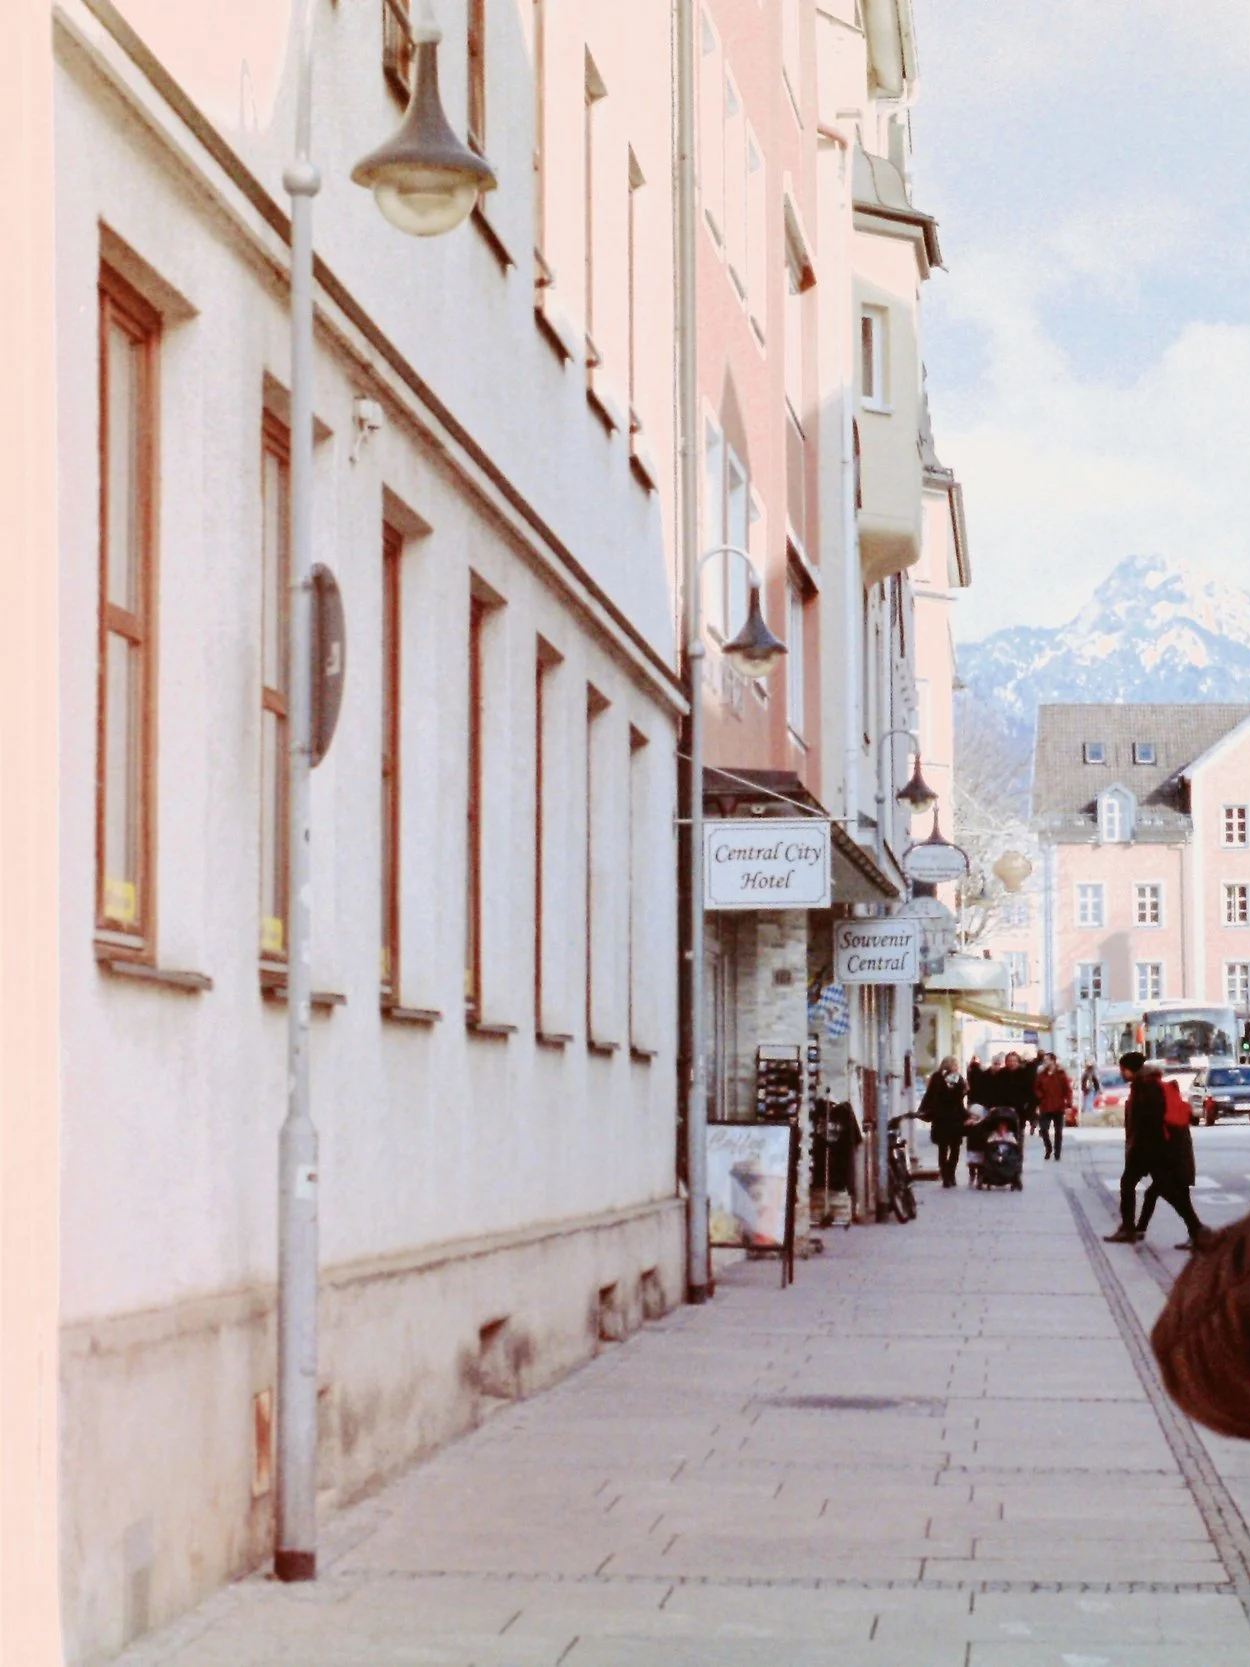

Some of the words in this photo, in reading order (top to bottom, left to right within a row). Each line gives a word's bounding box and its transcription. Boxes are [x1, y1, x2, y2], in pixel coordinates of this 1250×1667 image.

[715, 841, 783, 863] Central
[785, 842, 822, 866] City
[740, 869, 795, 891] Hotel
[840, 929, 912, 950] Souvenir
[847, 951, 909, 974] Central
